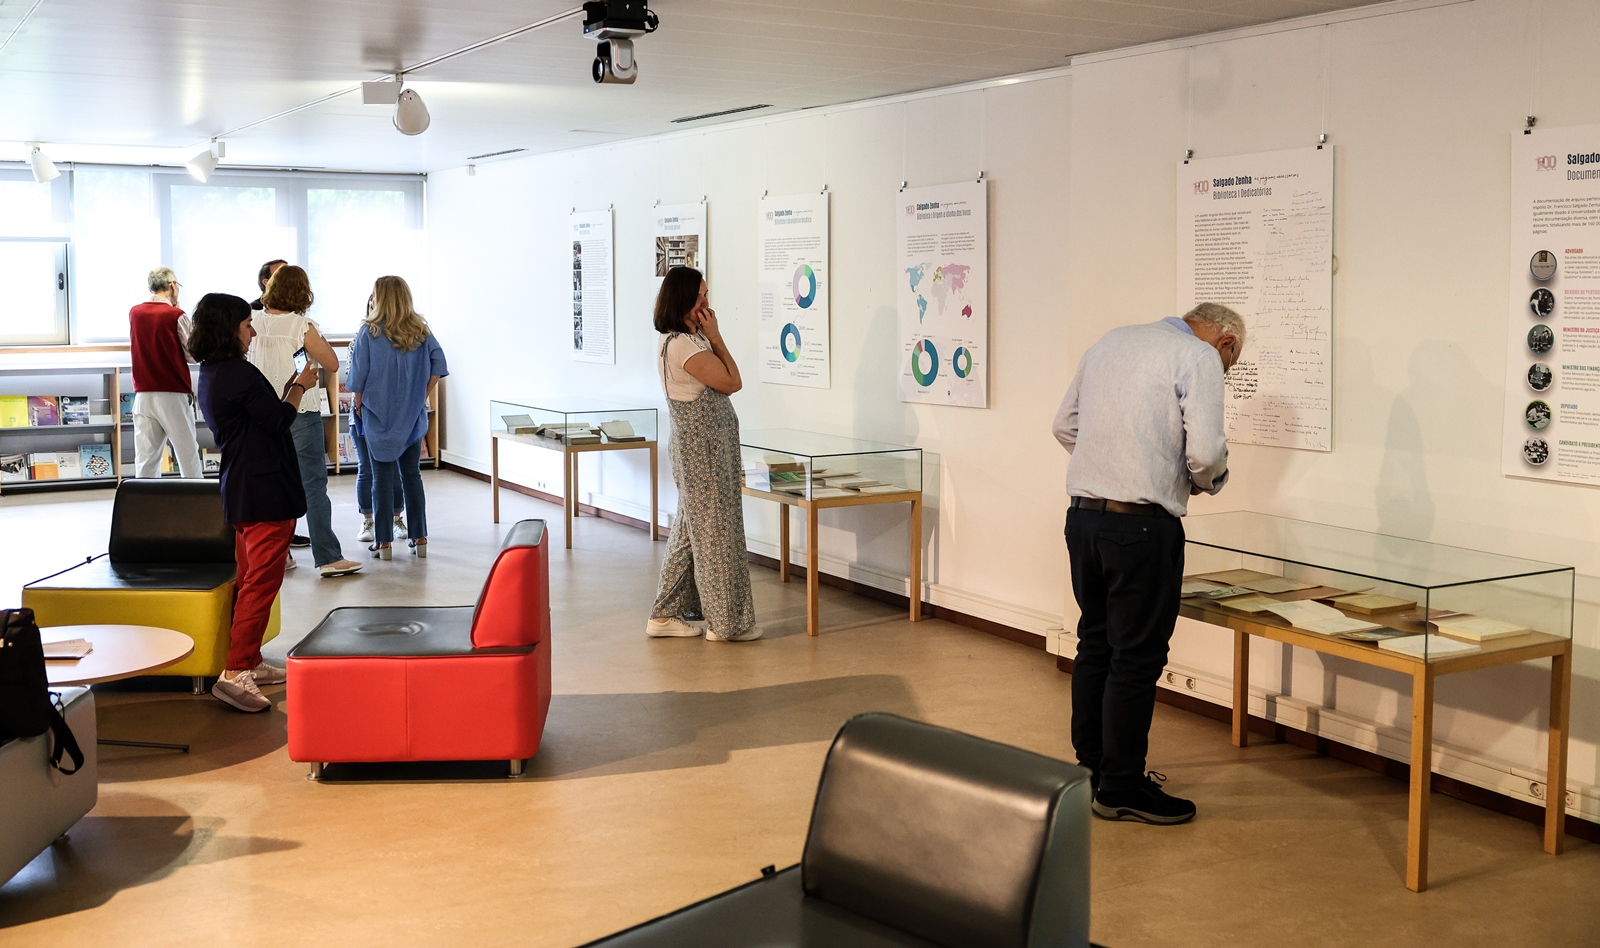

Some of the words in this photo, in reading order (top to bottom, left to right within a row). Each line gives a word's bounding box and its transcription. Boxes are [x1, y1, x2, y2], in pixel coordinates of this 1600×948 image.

[1567, 152, 1600, 165] Salgado
[1213, 177, 1234, 188] Salgado
[1235, 176, 1252, 185] Zenha
[1213, 189, 1237, 200] Biblioteca
[1241, 187, 1272, 198] Dedicatórias
